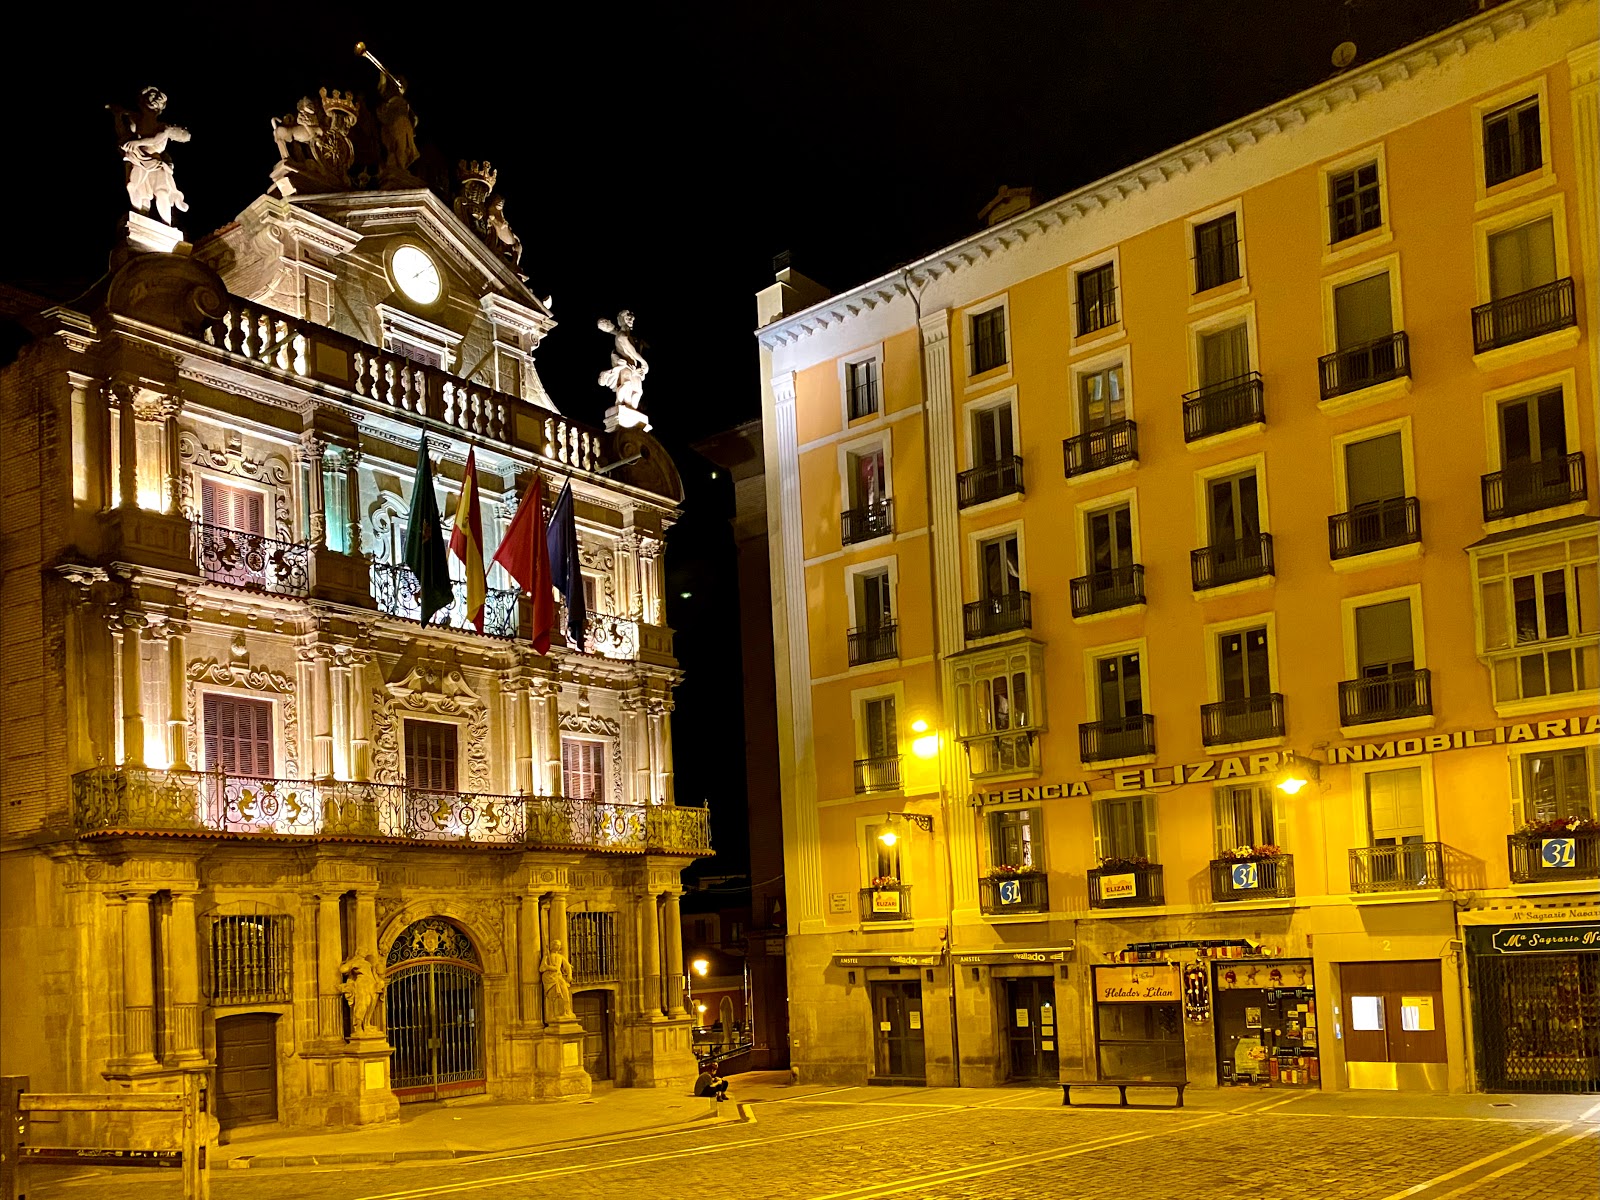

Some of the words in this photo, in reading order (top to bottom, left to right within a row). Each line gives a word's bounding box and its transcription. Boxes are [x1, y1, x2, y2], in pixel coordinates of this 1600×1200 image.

[967, 781, 1090, 807] AGENCIA
[1327, 715, 1600, 765] INMOBILIARIA
[1106, 884, 1133, 893] ELIZARI
[1526, 911, 1567, 921] Sagrario
[1382, 940, 1391, 951] 2
[1528, 933, 1580, 947] Sagrario
[1104, 987, 1140, 998] Helados
[1142, 986, 1173, 998] Lilian
